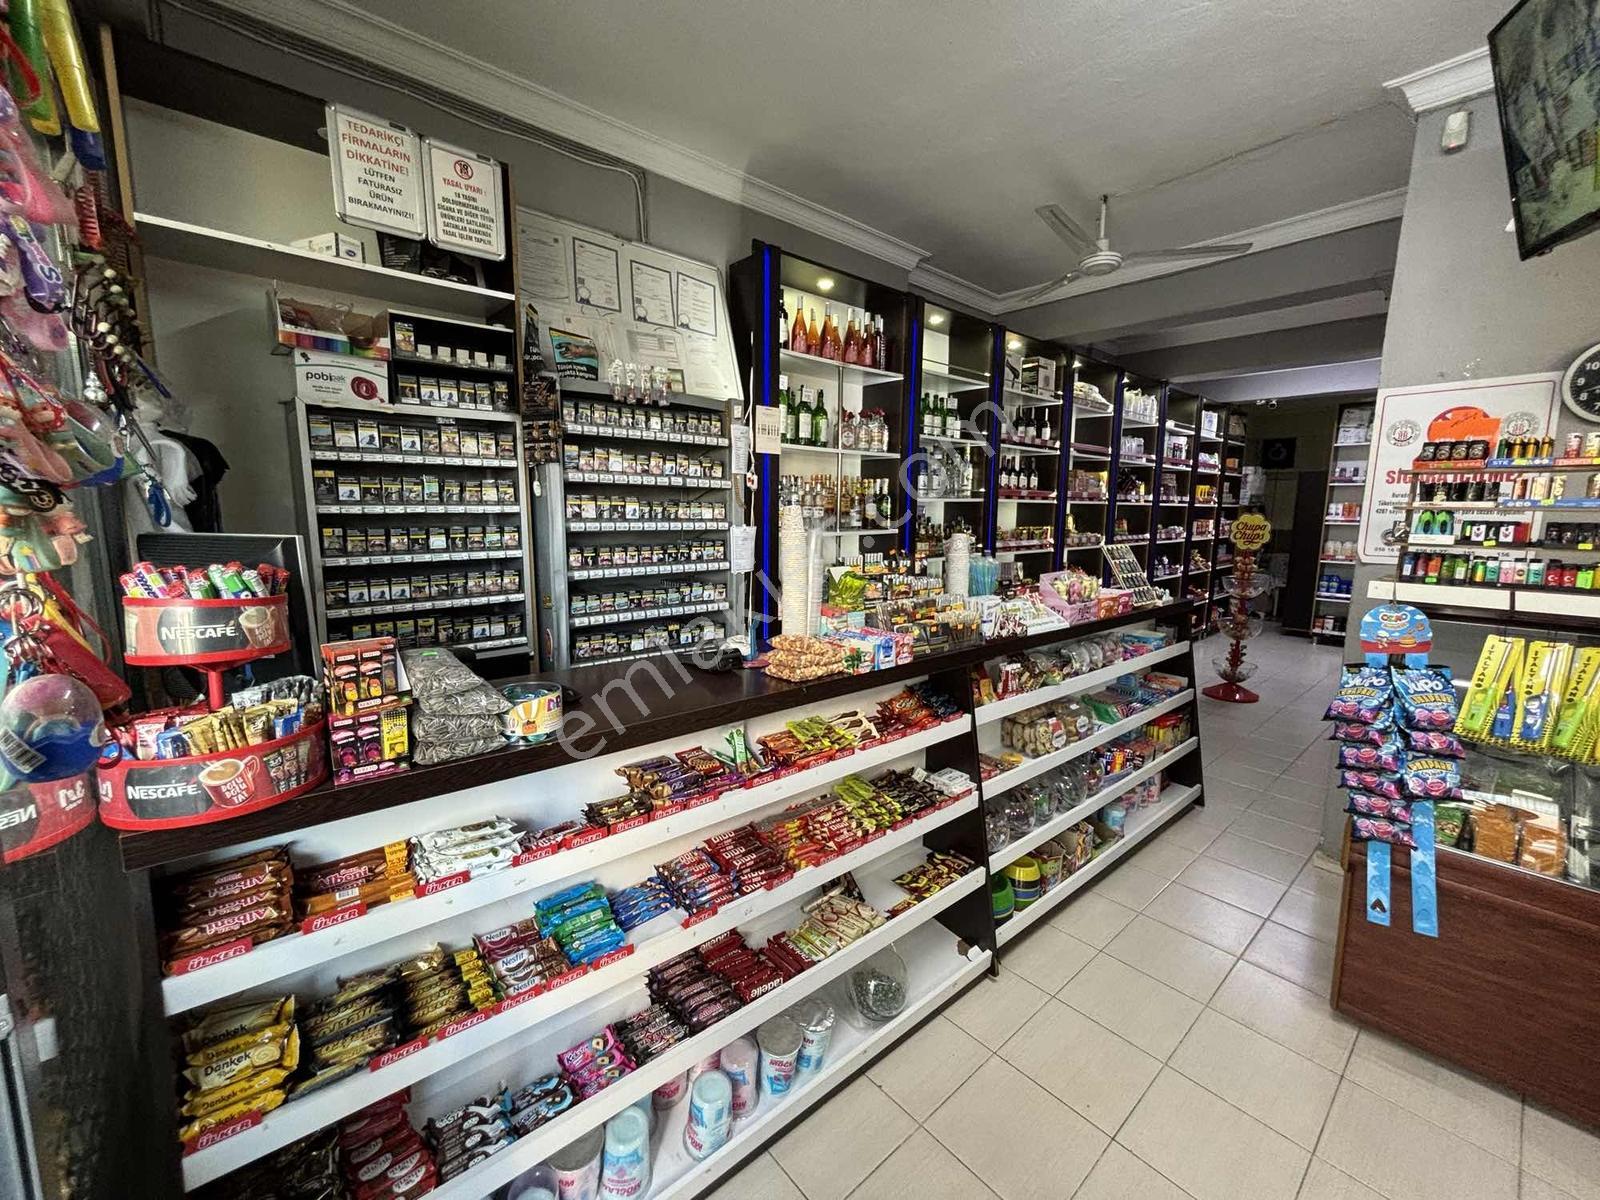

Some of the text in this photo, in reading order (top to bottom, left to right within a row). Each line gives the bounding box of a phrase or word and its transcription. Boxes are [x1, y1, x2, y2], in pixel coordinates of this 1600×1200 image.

[346, 120, 405, 147] TEDARİKÇİ
[342, 133, 410, 162] FİRMALARIN
[346, 149, 409, 176] DİKKATİNE!
[364, 167, 395, 183] LÜTFEN
[442, 177, 463, 190] YASAL
[357, 176, 403, 196] FATURASIZ
[369, 190, 394, 204] ÜRÜN
[1586, 361, 1600, 370] 10
[1577, 377, 1586, 386] 9
[1580, 392, 1588, 400] 8
[1236, 521, 1268, 533] Chupa
[1233, 529, 1266, 546] Chups
[425, 875, 465, 895] ÜLKER
[312, 909, 359, 931] ÜLKER
[485, 929, 509, 942] Nesfit
[188, 945, 246, 972] ÜLKER
[501, 952, 525, 969] Nesfit
[512, 977, 536, 993] Nesfit
[551, 968, 584, 990] ÜLKER
[500, 991, 536, 1012] ÜLKER
[445, 1012, 486, 1038] ÜLKER
[204, 1051, 252, 1077] Dankek
[380, 1040, 423, 1068] ÜLKER
[202, 1090, 238, 1110] Dankek
[199, 1119, 252, 1148] ÜLKER
